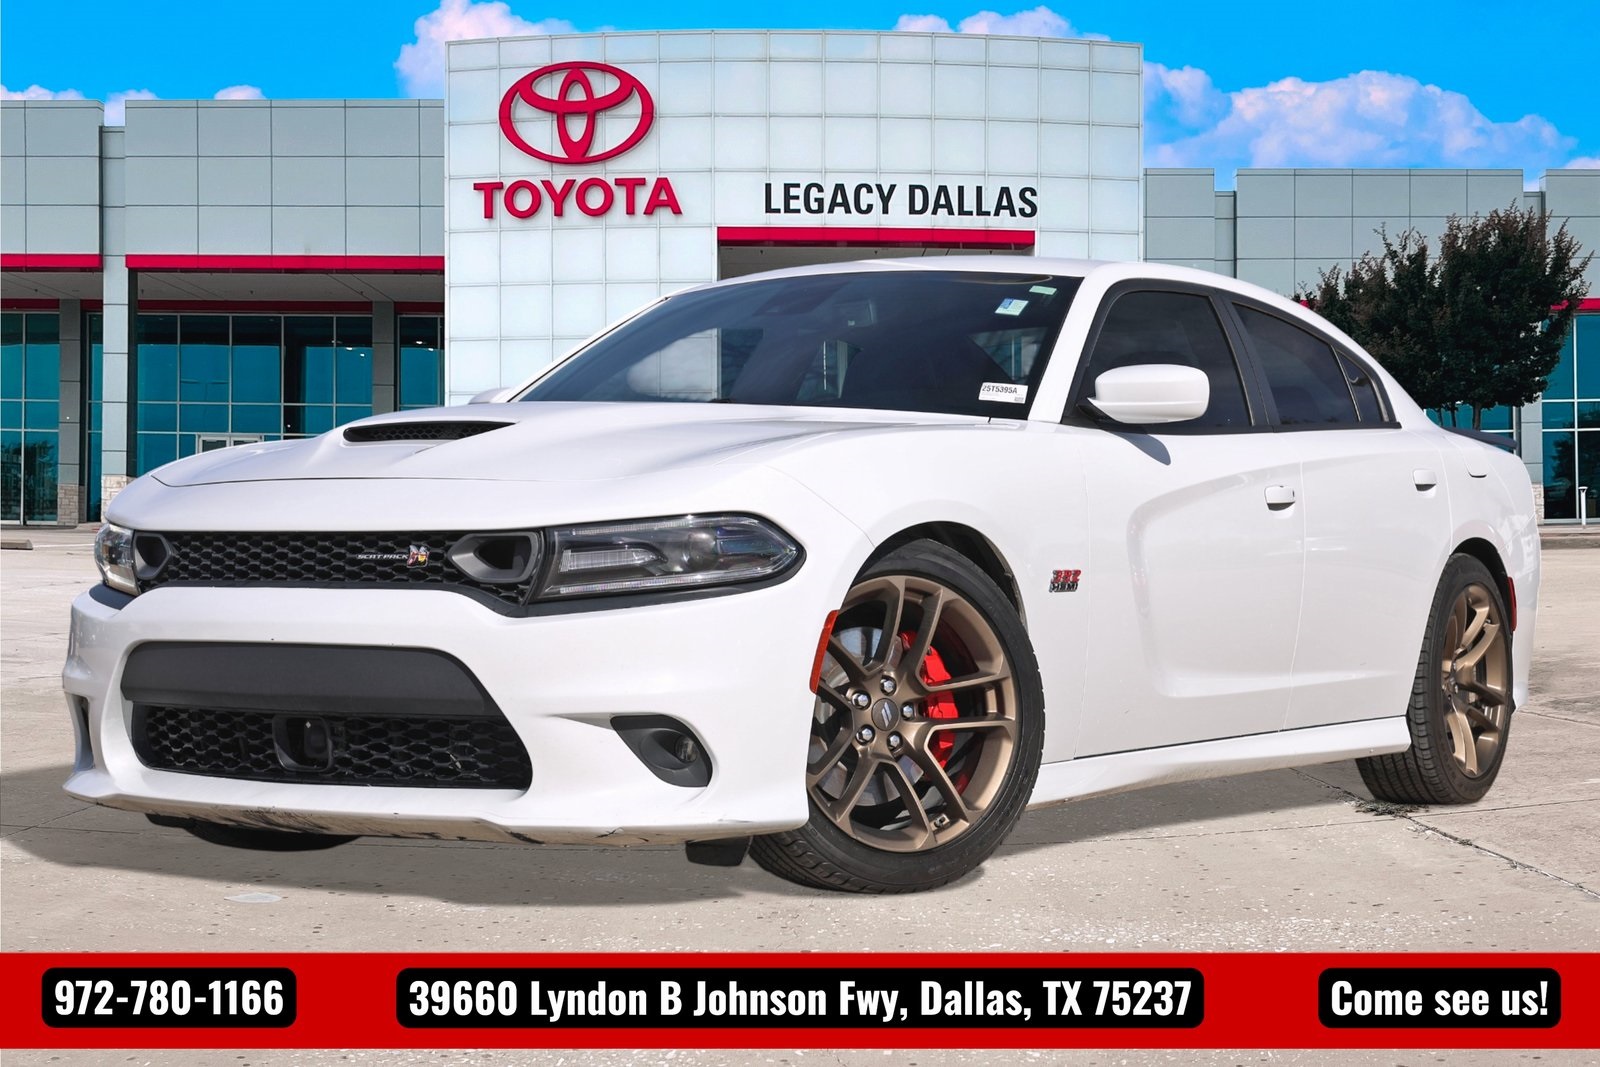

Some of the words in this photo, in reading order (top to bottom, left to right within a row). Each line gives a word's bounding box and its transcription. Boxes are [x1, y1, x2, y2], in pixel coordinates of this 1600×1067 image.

[473, 177, 683, 219] TOYOTA
[764, 182, 897, 215] LEGACY
[908, 184, 1038, 218] DALLAS
[981, 384, 1018, 394] 25T5395A
